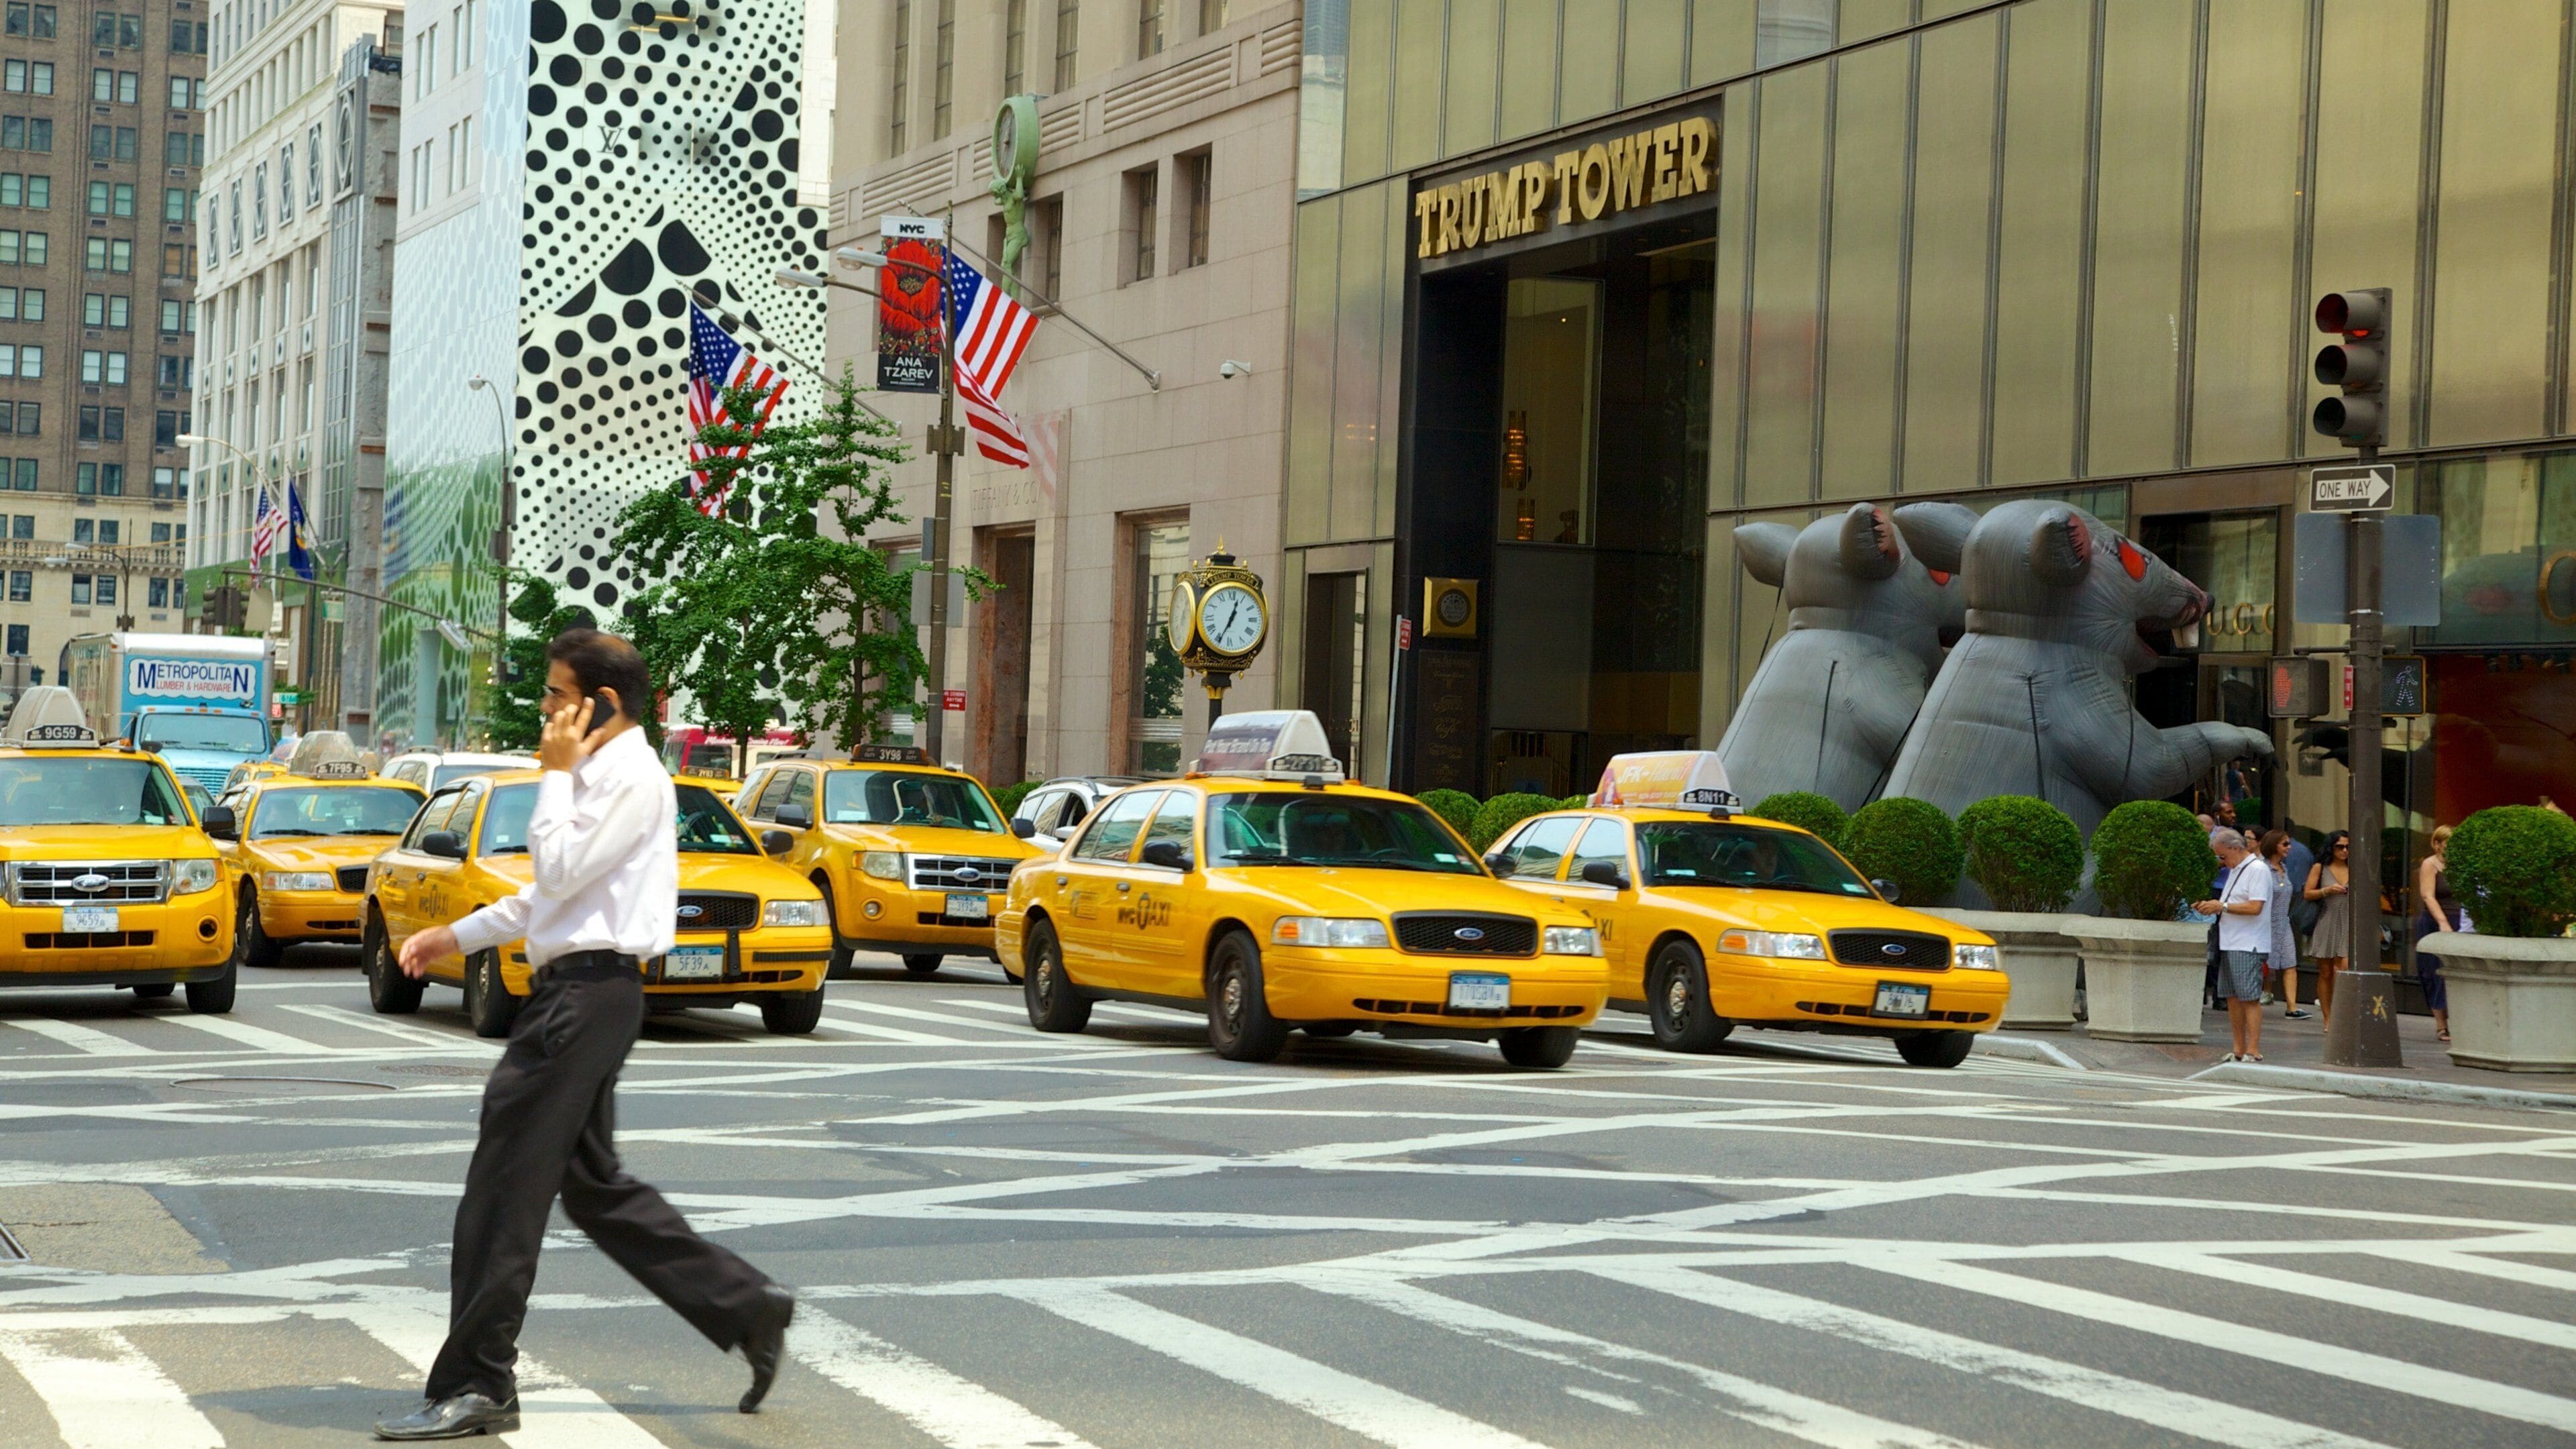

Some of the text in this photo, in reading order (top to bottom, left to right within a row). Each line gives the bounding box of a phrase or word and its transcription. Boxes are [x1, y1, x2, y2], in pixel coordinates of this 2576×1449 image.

[1415, 117, 1719, 259] TRUMP TOWER
[900, 223, 924, 233] NYC
[895, 356, 922, 368] ANA
[883, 366, 933, 379] TZAREV
[2320, 480, 2371, 498] ONE WAY
[1210, 574, 1254, 584] TRUMP TOWER
[138, 663, 249, 693] METROPOLITAN
[156, 680, 231, 692] LUMBER & HARDWARE
[45, 727, 76, 739] 9G59
[879, 749, 902, 761] 3Y98
[329, 763, 352, 773] 7F95
[1698, 791, 1725, 804] 8N11
